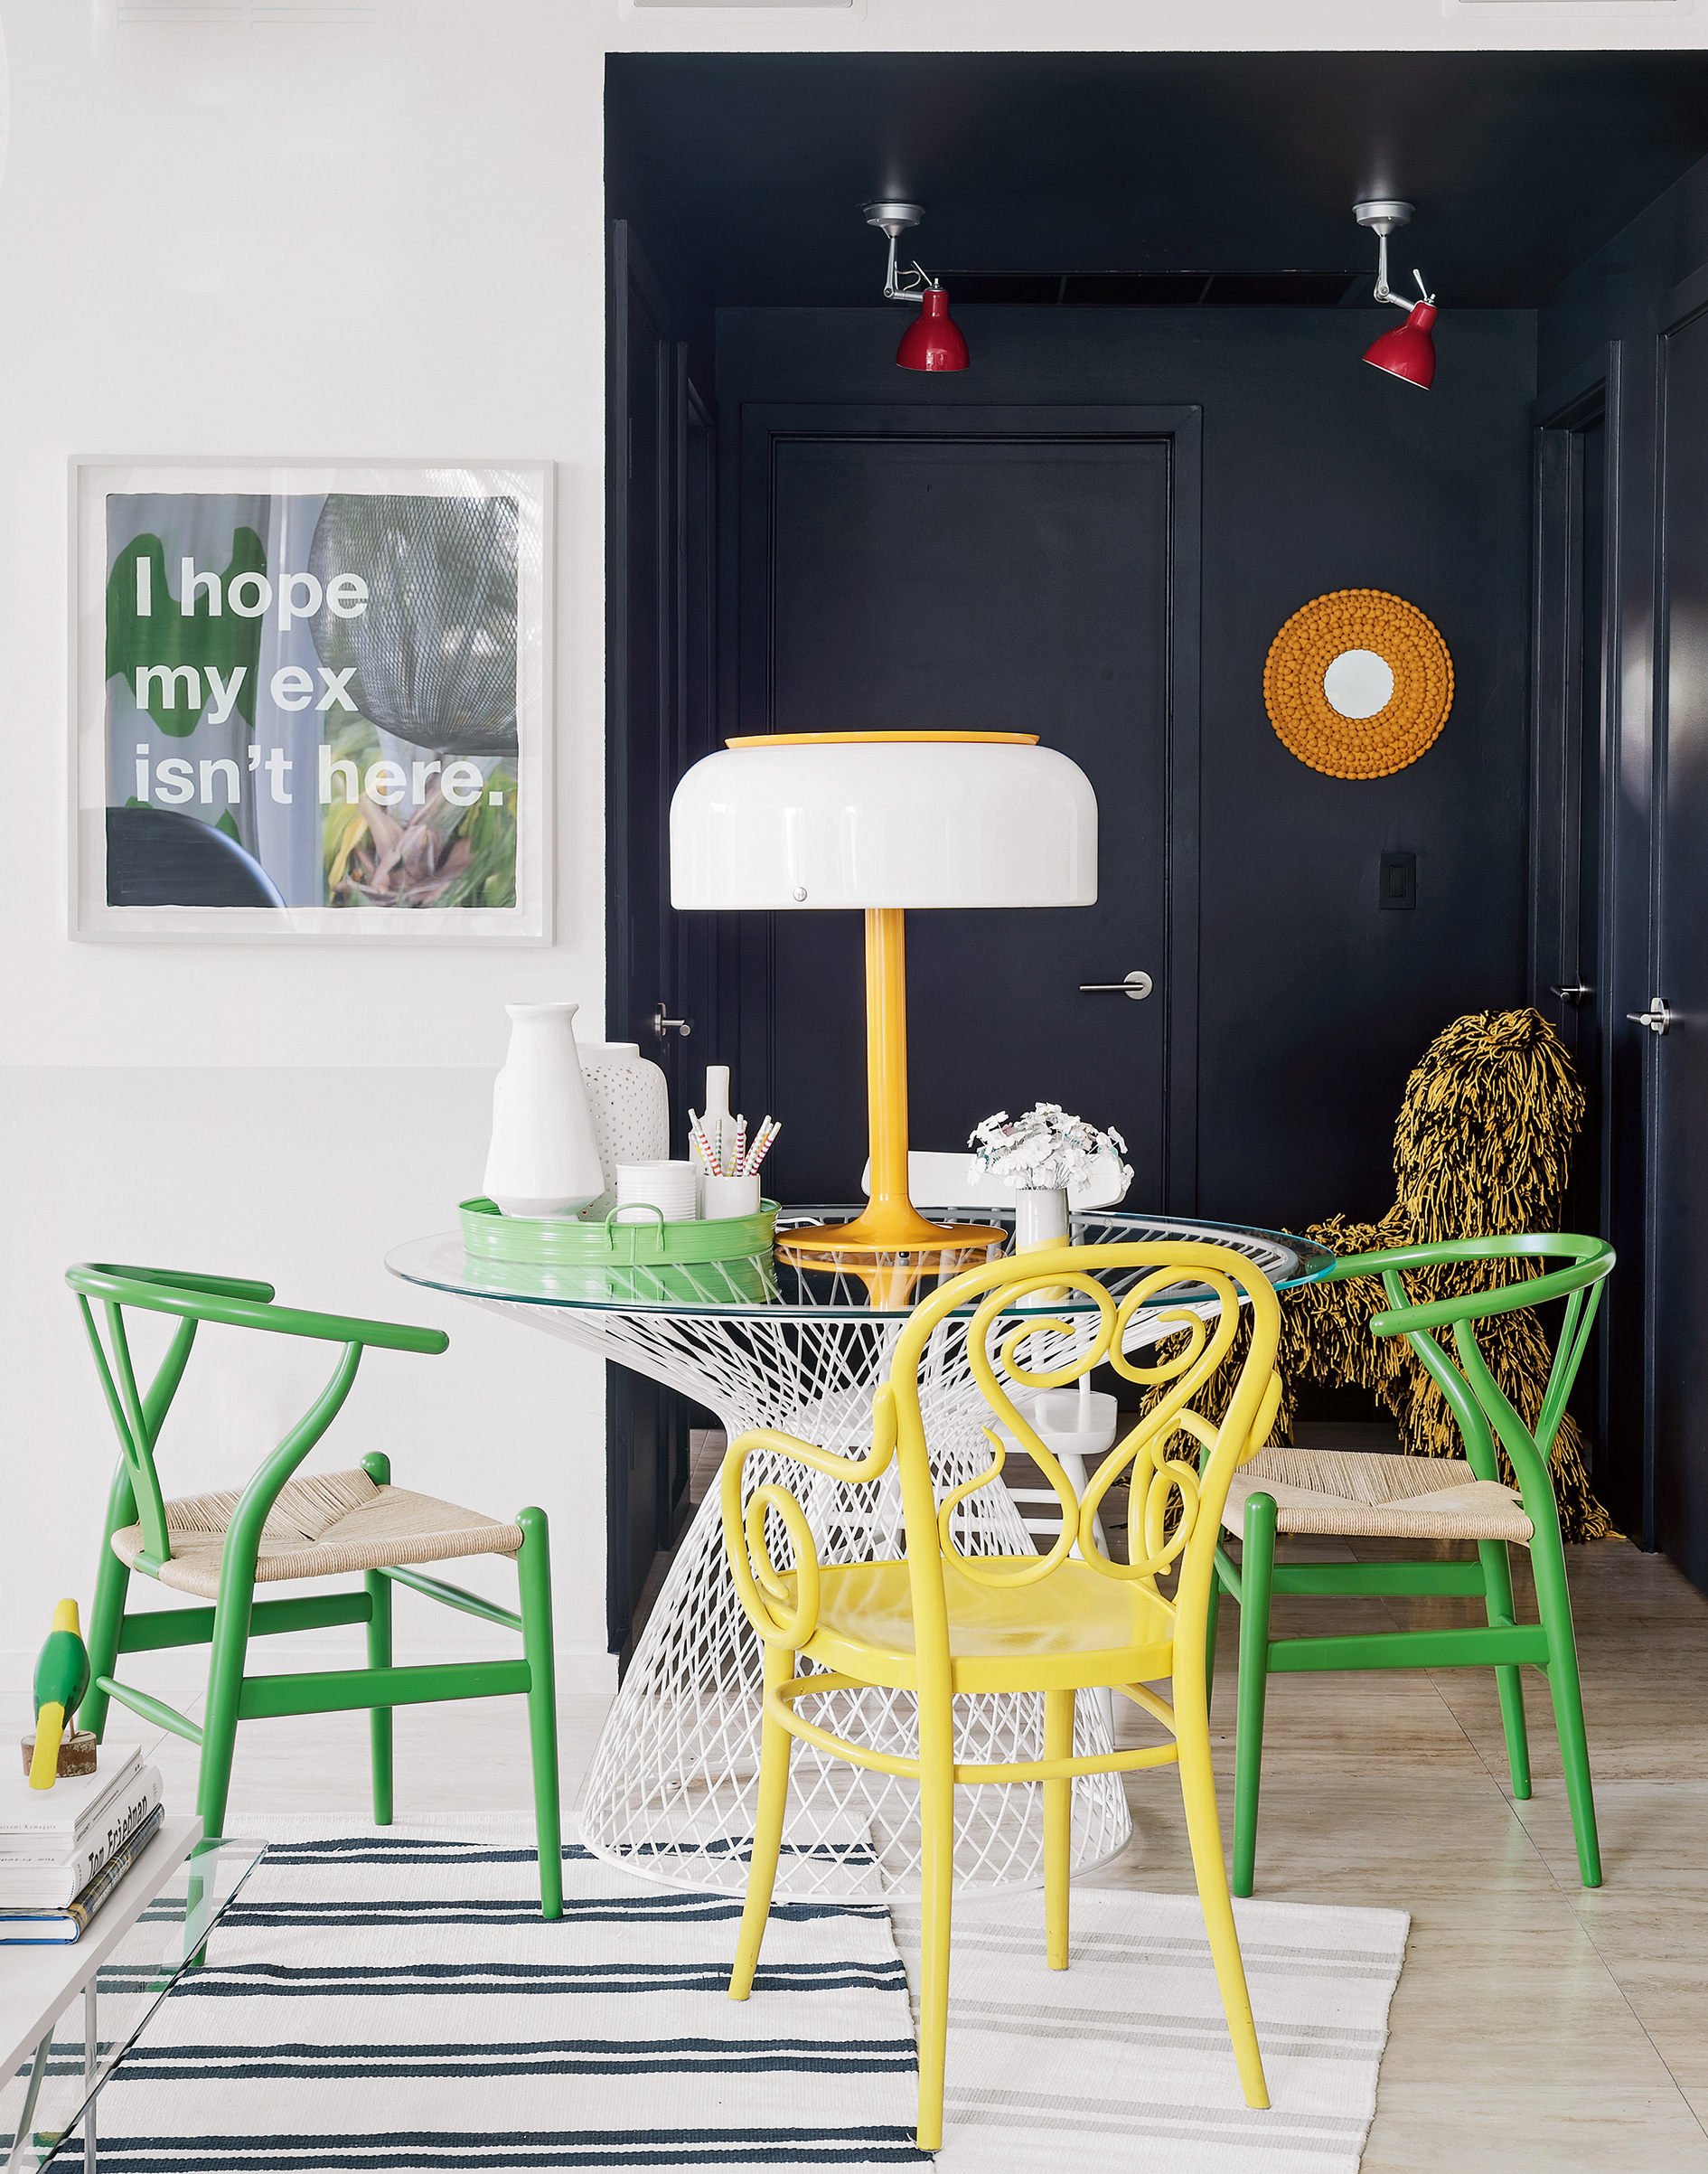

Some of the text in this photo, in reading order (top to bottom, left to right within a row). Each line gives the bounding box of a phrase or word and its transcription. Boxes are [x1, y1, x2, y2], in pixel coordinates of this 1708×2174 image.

[136, 557, 370, 631] I hope
[136, 663, 358, 725] my ex
[136, 744, 503, 805] isn’t here.
[88, 1846, 105, 1882] Tom
[107, 1795, 147, 1860] Friedman
